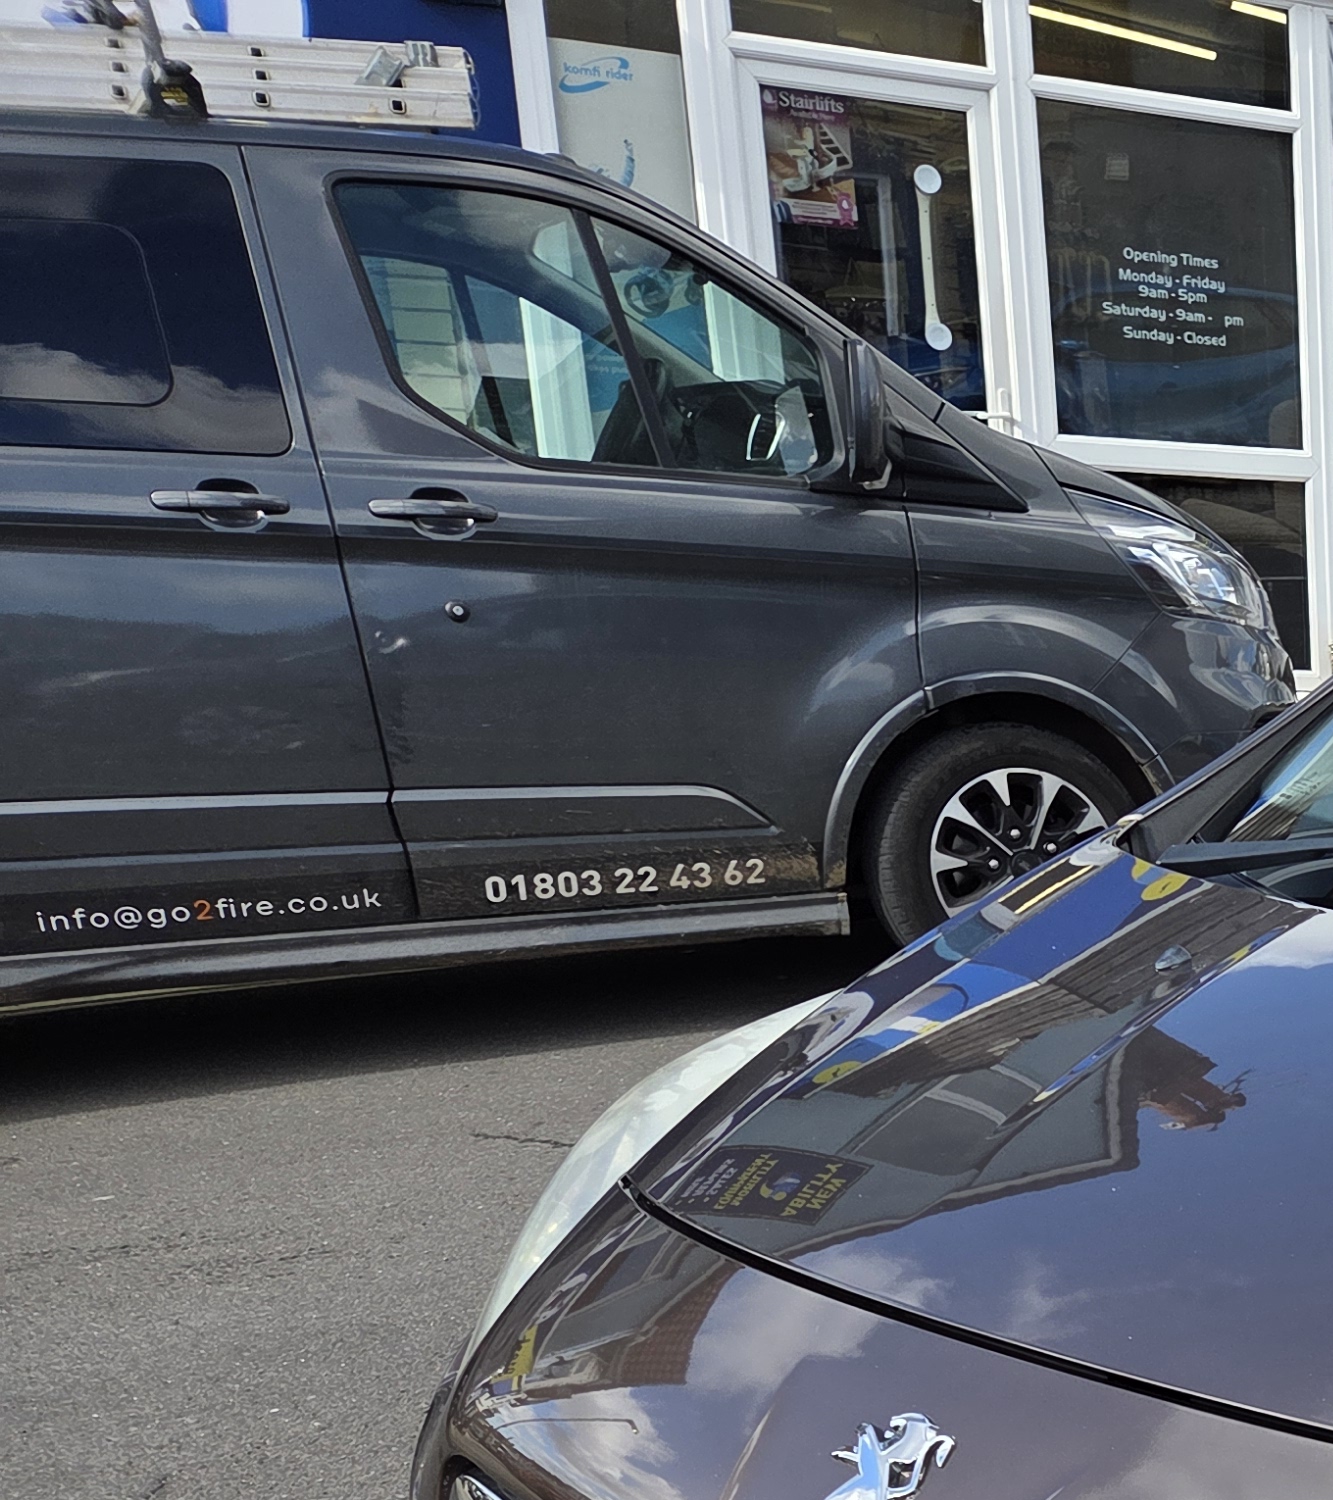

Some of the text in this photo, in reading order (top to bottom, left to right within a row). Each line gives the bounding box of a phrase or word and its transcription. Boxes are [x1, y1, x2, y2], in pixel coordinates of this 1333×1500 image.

[606, 68, 634, 81] rider
[779, 91, 844, 113] Stairlifts
[1123, 246, 1219, 269] Opening Times
[1118, 268, 1173, 287] Monday
[1182, 275, 1226, 294] Friday
[1138, 285, 1169, 299] 9am
[1178, 289, 1207, 304] 5pm
[1102, 302, 1166, 322] Saturday
[1175, 309, 1205, 323] 9am
[1224, 315, 1244, 328] pm
[1123, 326, 1175, 345] Sunday
[1183, 331, 1227, 347] Closed
[484, 858, 766, 903] 01803 22 43 62
[35, 888, 382, 932] info@go2fire.co.uk
